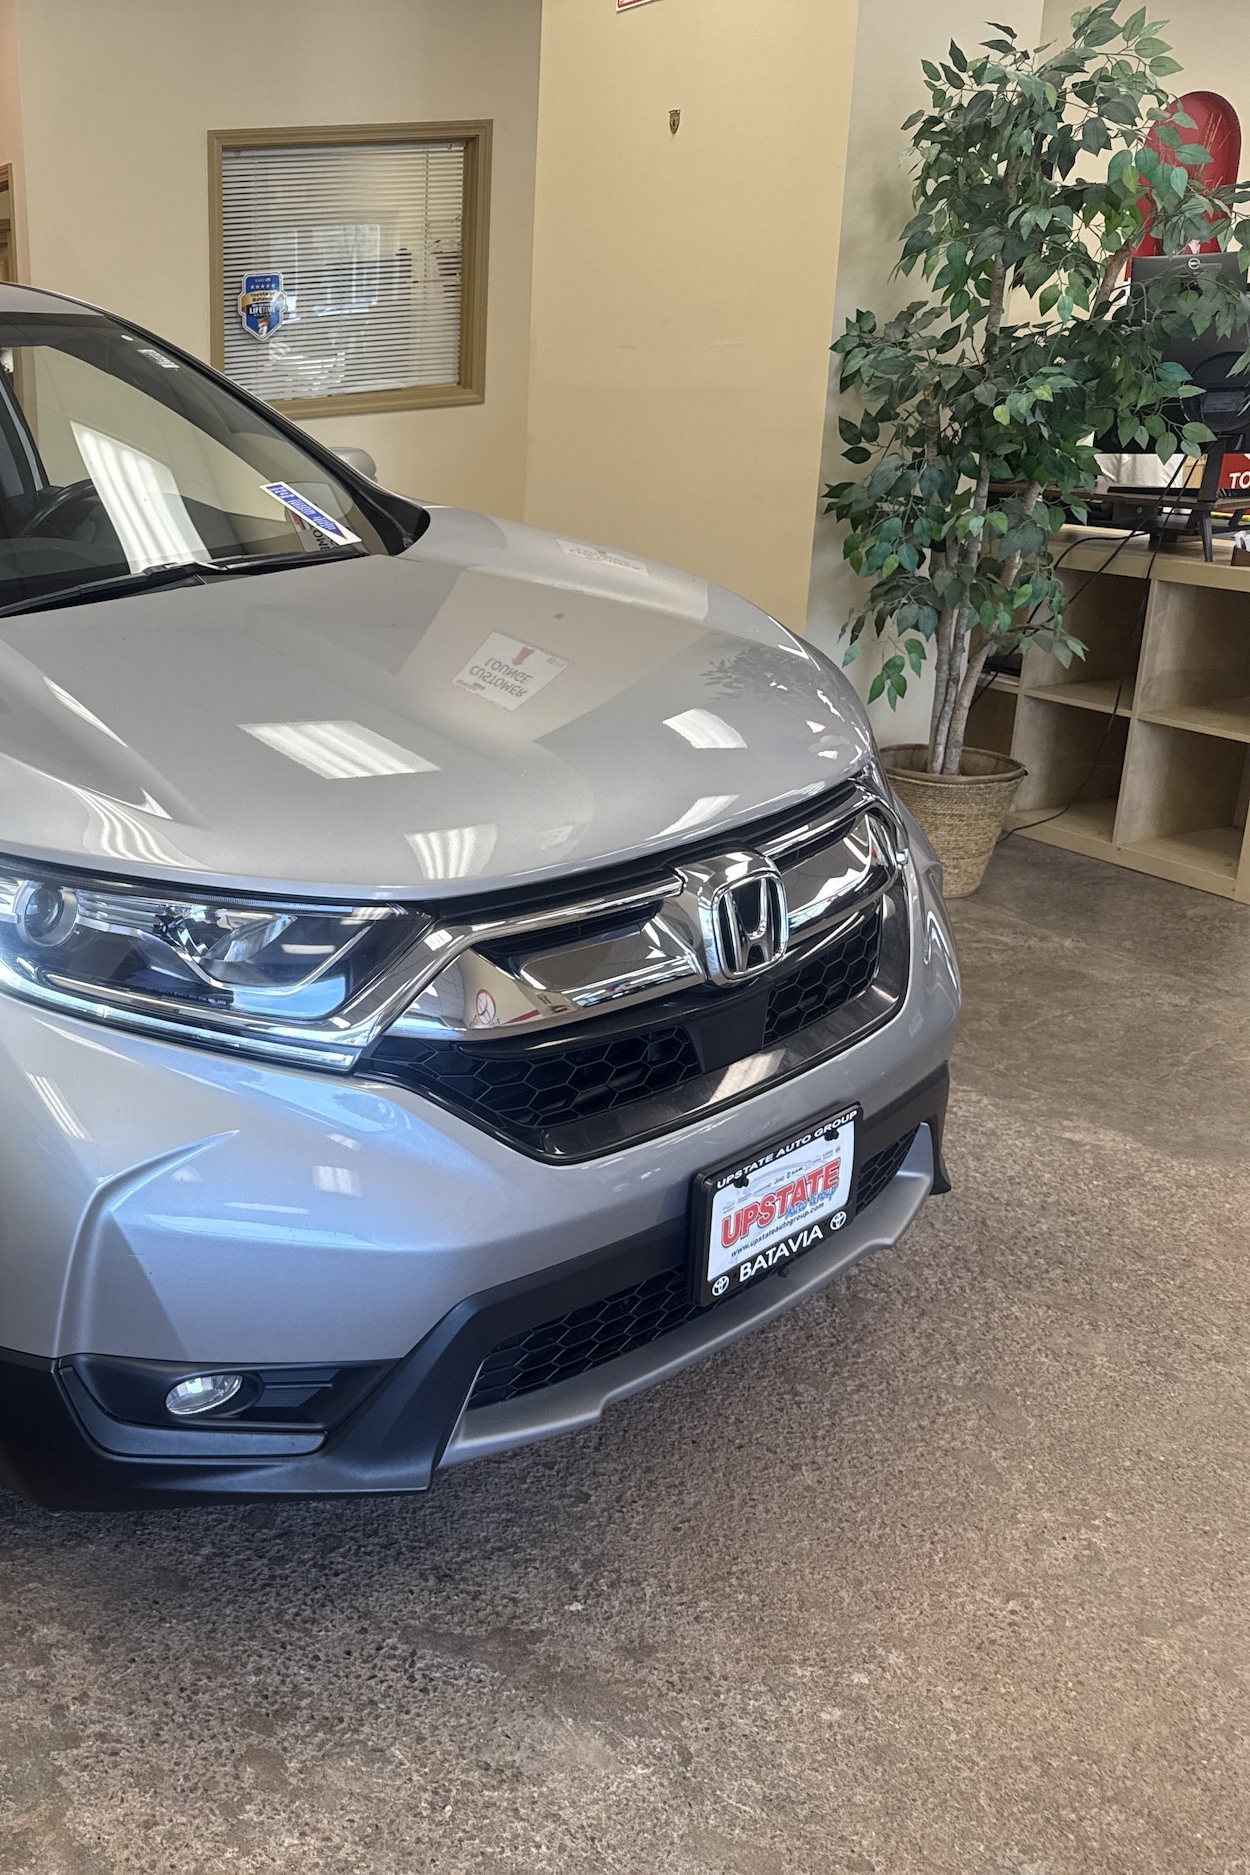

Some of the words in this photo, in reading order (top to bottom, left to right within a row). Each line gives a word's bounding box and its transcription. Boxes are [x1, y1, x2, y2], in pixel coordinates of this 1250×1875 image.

[716, 1153, 774, 1189] UPSTATE
[775, 1134, 812, 1159] AUTO
[814, 1110, 858, 1138] GROUP
[721, 1157, 841, 1248] UPSTATE
[731, 1202, 824, 1257] www.upstateautogroup.com
[739, 1225, 824, 1282] BATAVIA
